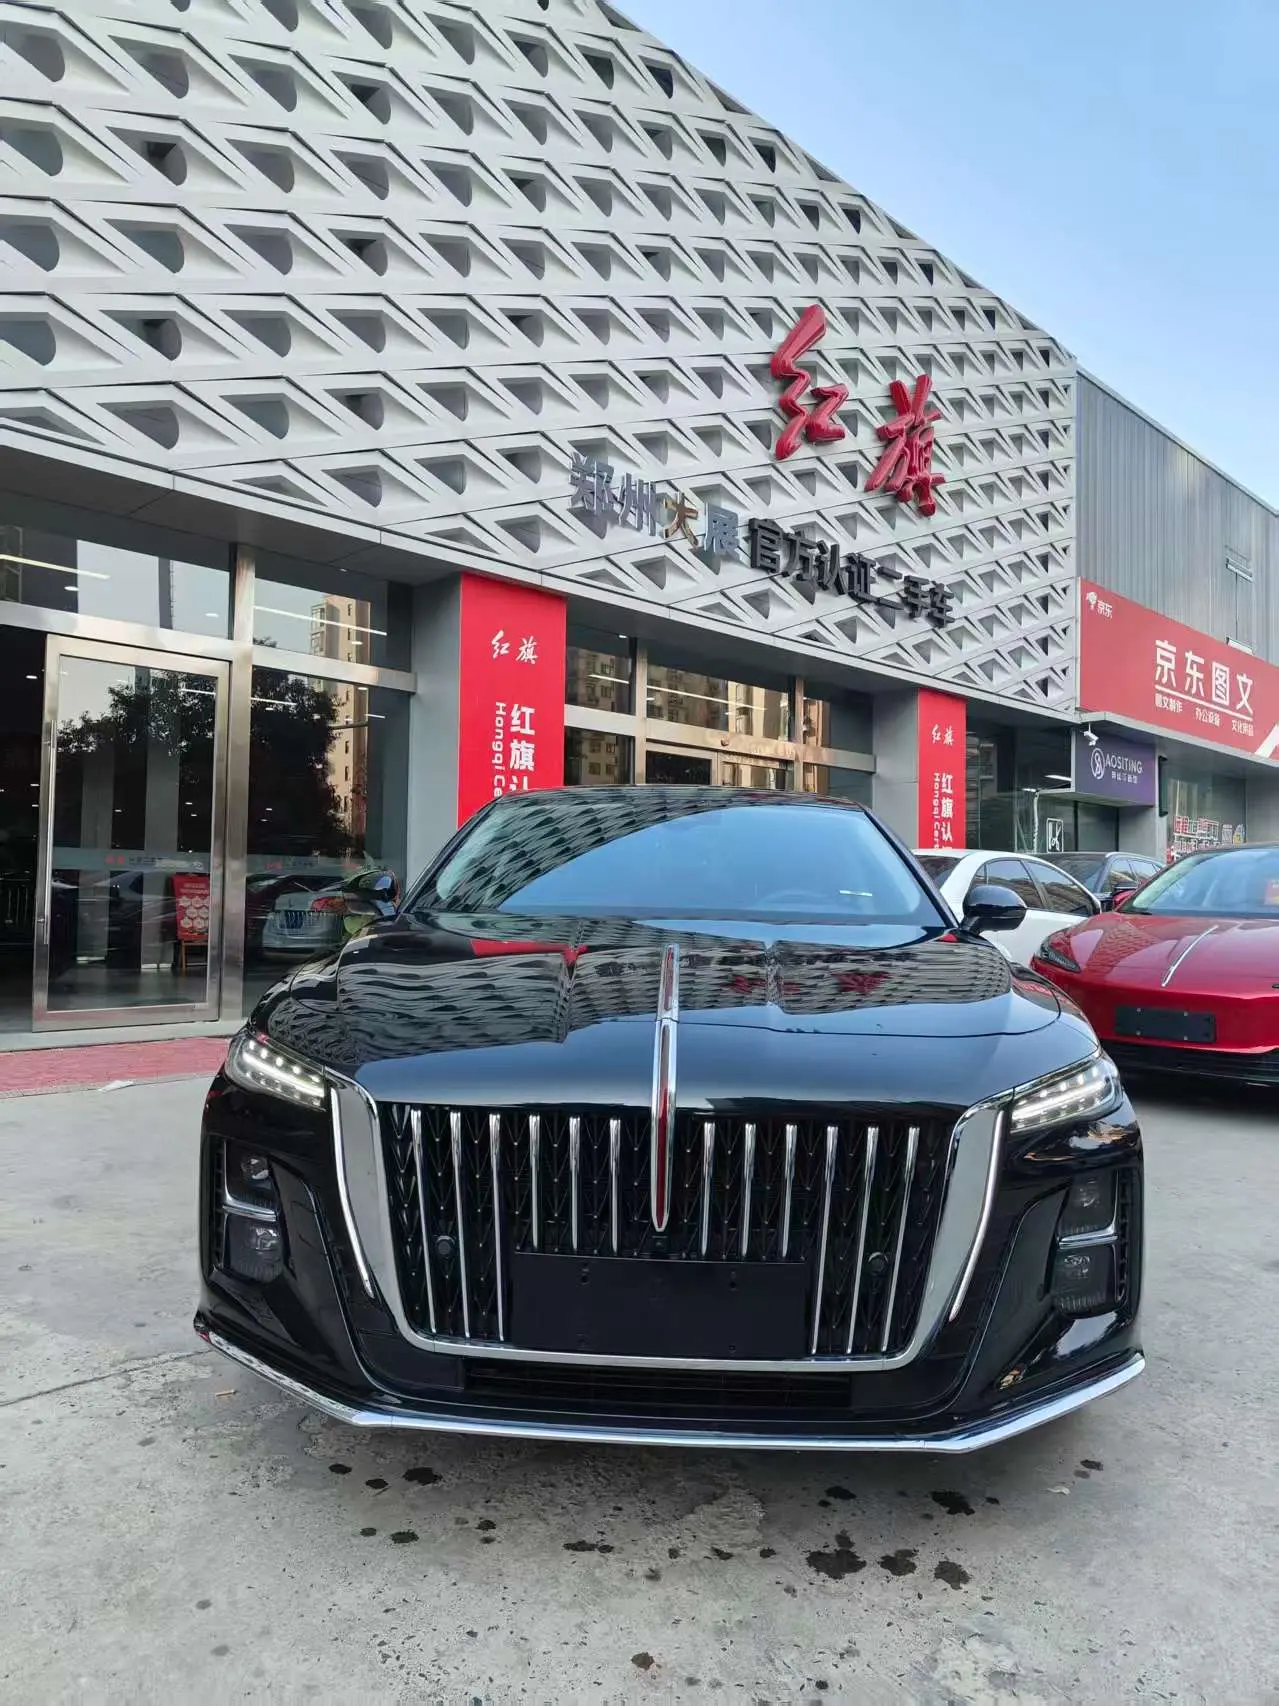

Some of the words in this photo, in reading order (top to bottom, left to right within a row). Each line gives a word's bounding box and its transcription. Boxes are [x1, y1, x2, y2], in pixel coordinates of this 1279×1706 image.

[770, 303, 946, 517] 红旗
[570, 452, 742, 564] 郑州大展
[749, 517, 955, 629] 官方认证二手车
[1097, 599, 1113, 619] 京东
[491, 629, 539, 665] 红旗
[1155, 639, 1254, 715] 京东图文
[492, 702, 506, 770] Hongqi
[931, 723, 954, 746] 红旗
[1105, 753, 1143, 774] AOSITING
[932, 772, 940, 818] Hongqi
[941, 772, 953, 849] 红旗认
